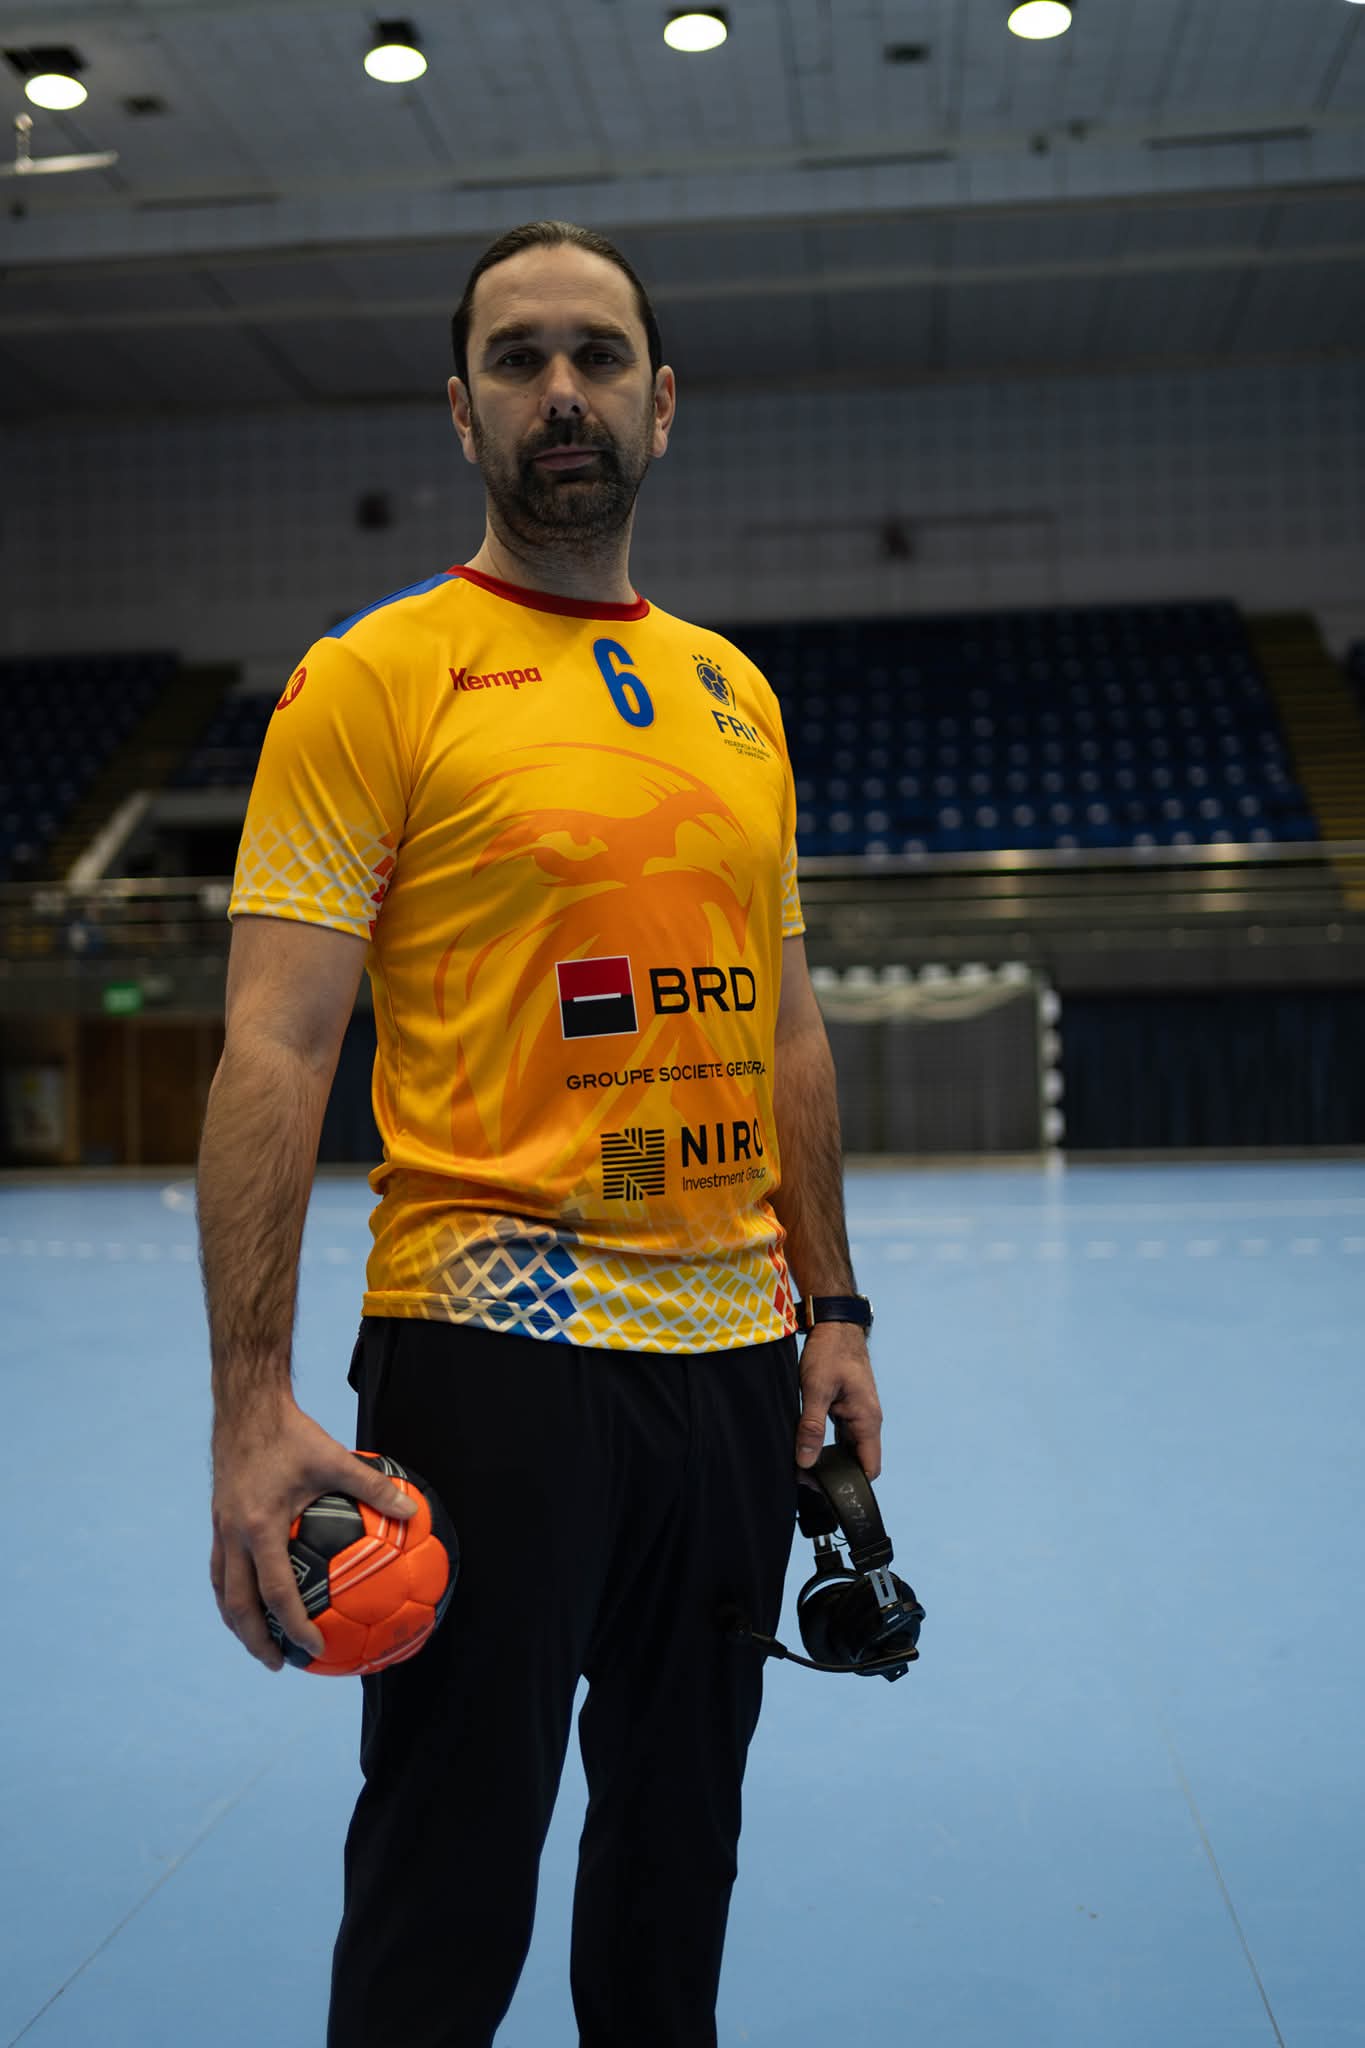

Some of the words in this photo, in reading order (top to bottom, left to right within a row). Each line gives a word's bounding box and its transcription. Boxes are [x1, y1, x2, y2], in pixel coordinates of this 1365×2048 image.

[449, 667, 542, 691] Kempa
[592, 638, 655, 728] 6
[649, 967, 756, 1014] BRD
[566, 1068, 655, 1090] GROUPE
[659, 1063, 723, 1082] SOCIETE
[681, 1117, 763, 1168] NIRO
[682, 1169, 744, 1192] Investment
